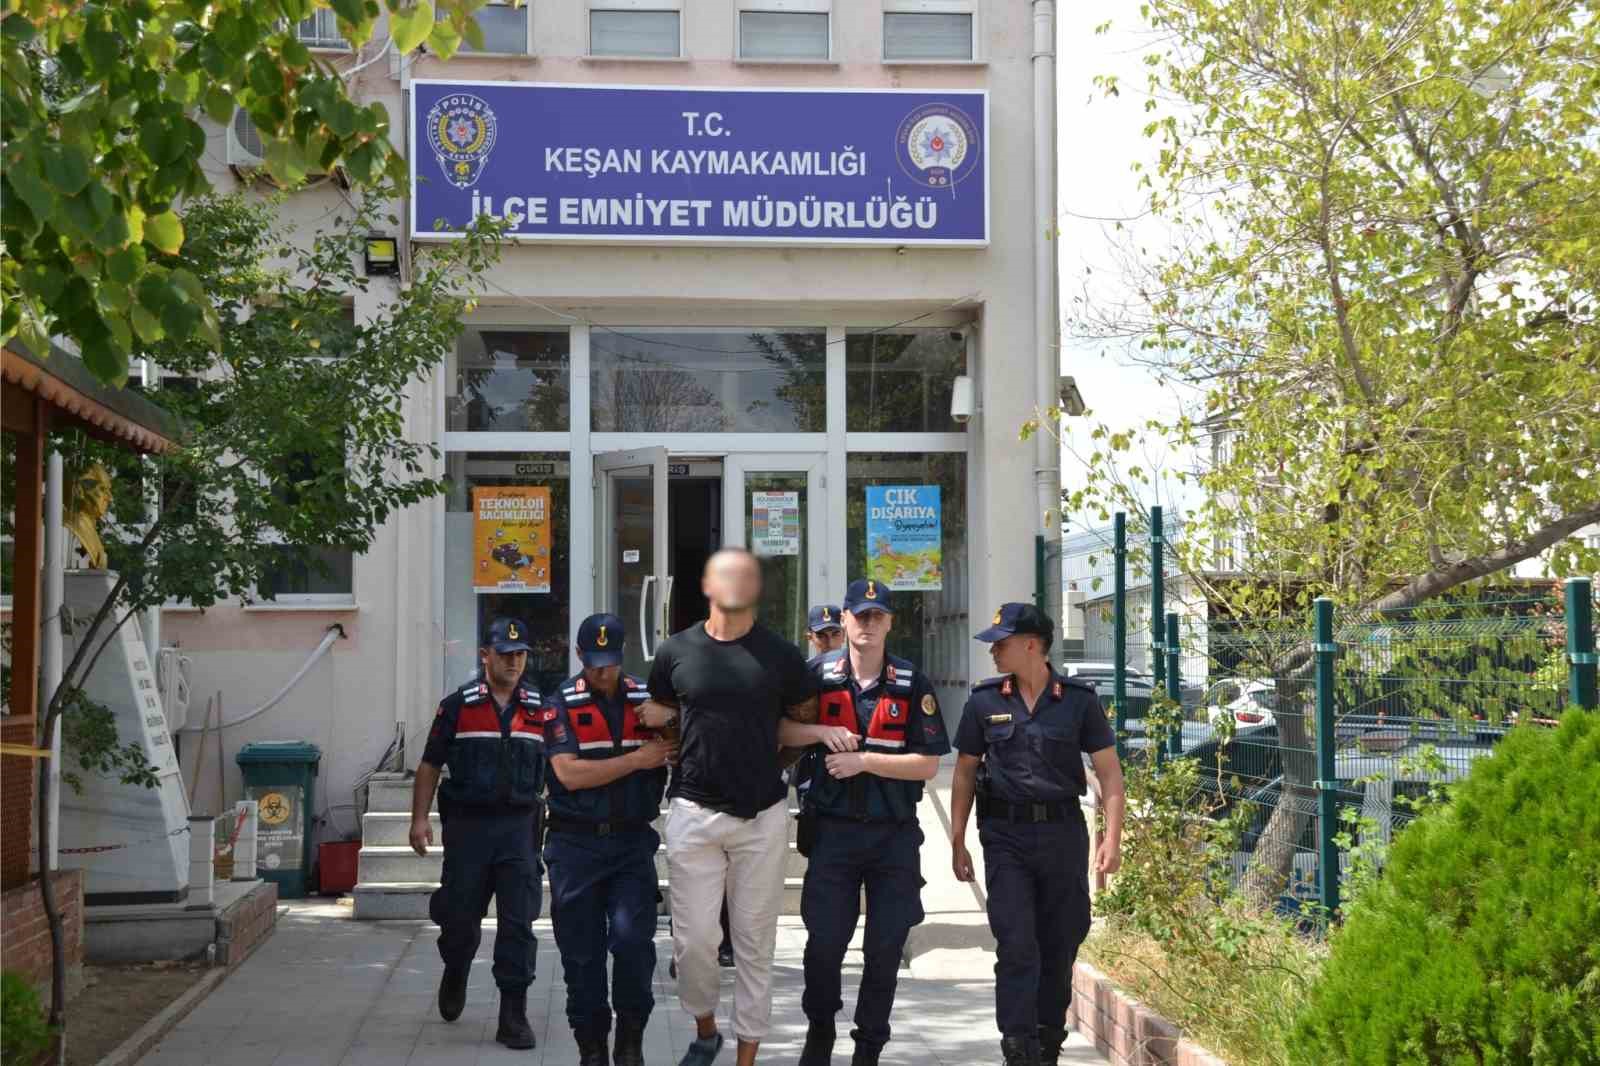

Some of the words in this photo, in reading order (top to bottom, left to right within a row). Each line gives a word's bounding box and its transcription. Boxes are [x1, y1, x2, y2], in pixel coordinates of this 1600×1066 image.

[682, 111, 731, 137] T.C.
[544, 147, 642, 178] KEŞAN
[651, 145, 867, 176] KAYMAKAMLIĞI
[471, 189, 548, 230] İLÇE
[559, 192, 712, 227] EMNİYET
[723, 195, 937, 229] MÜDÜRLÜĞÜ
[885, 488, 917, 509] ÇIK
[872, 506, 936, 521] DIŞARIYA
